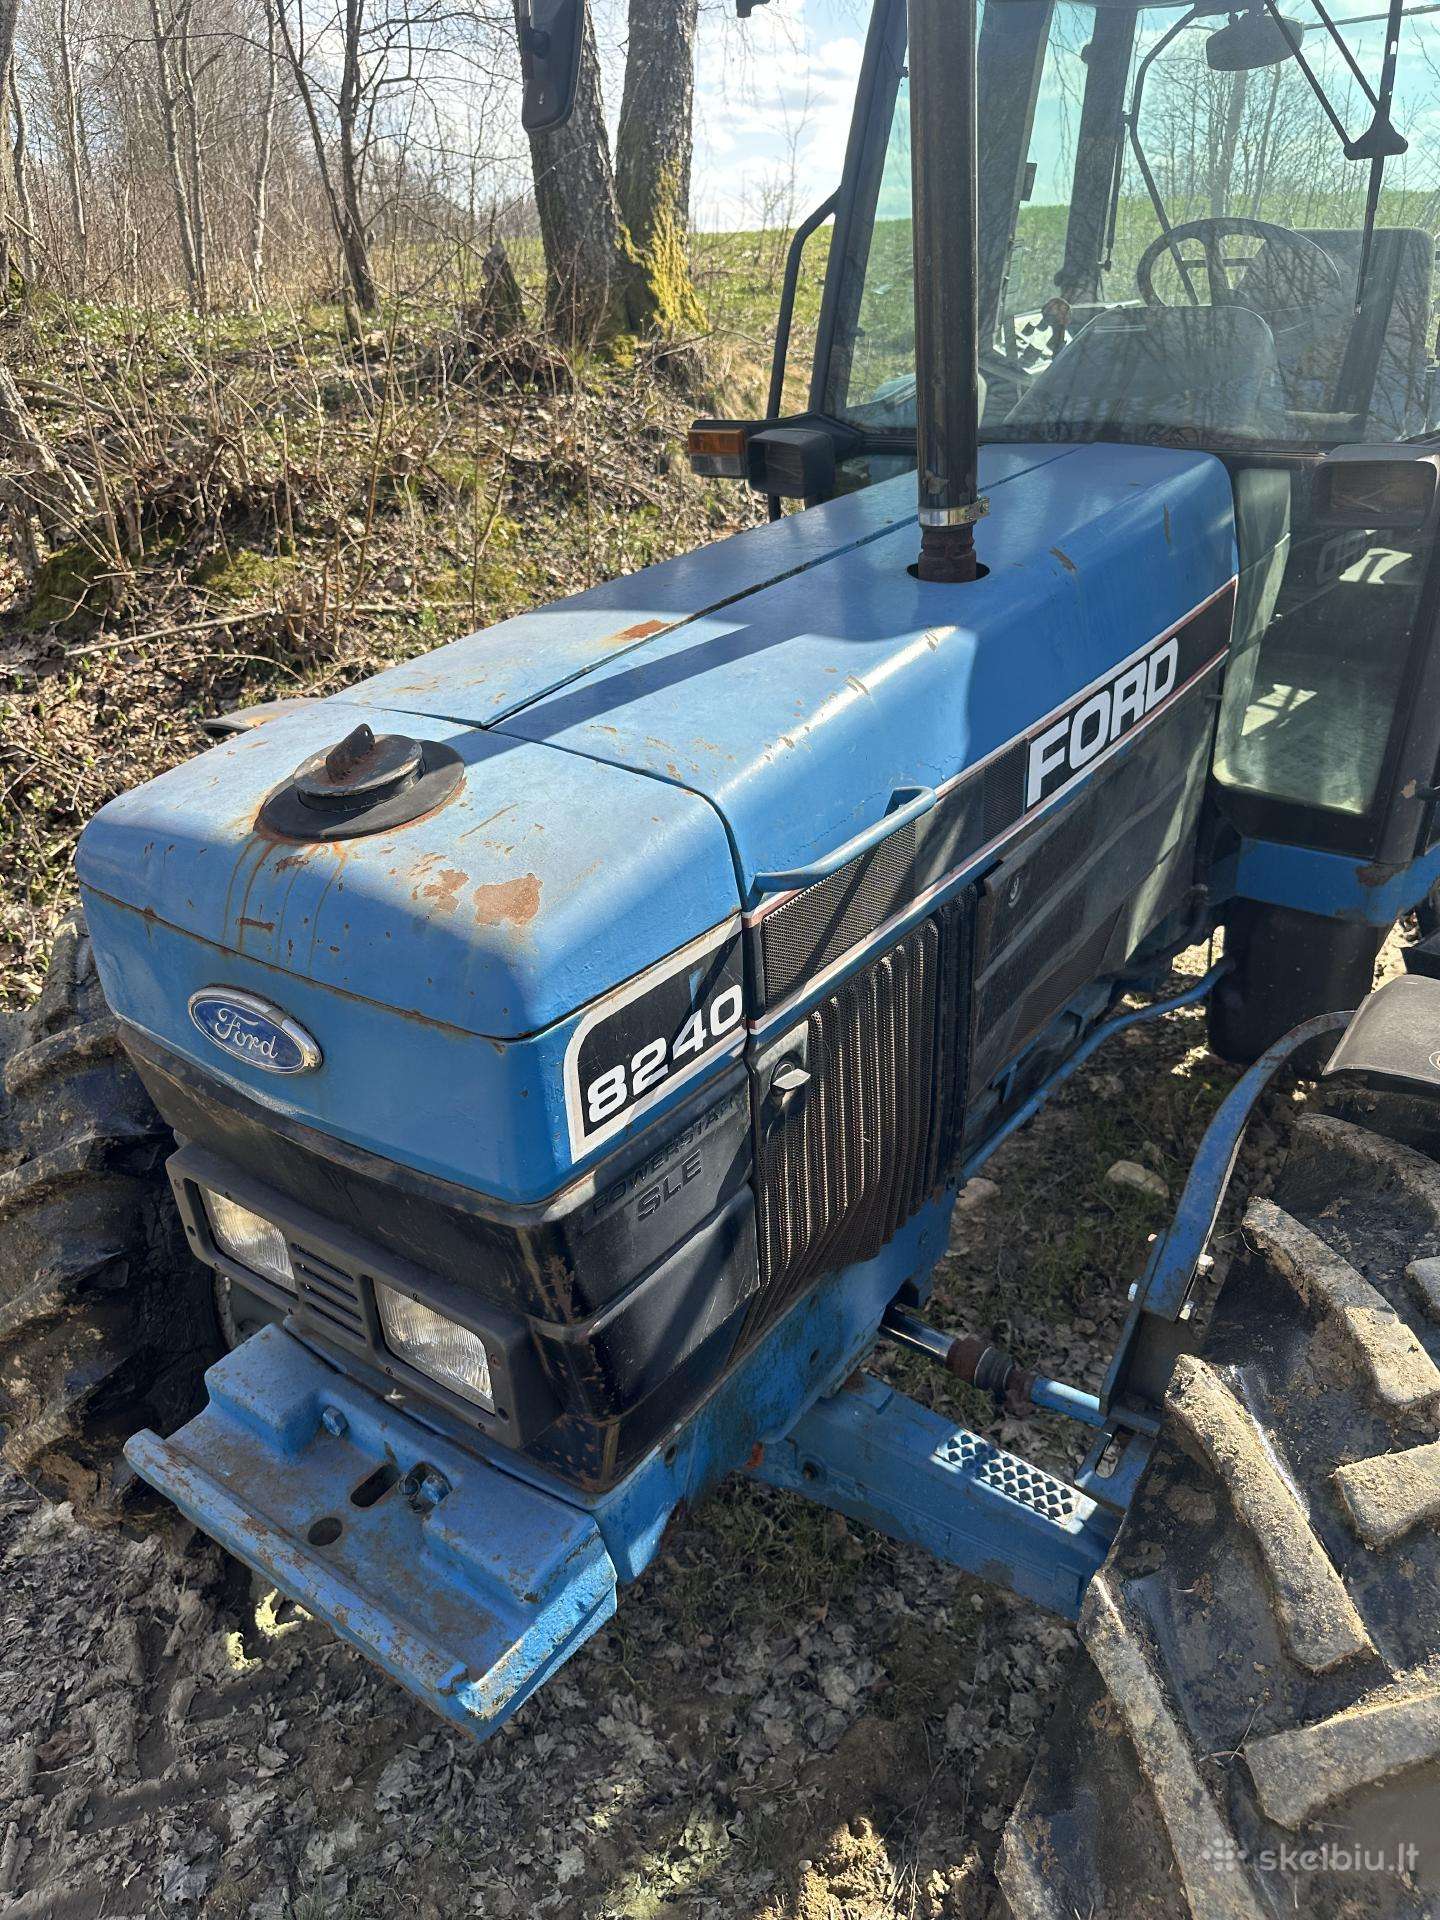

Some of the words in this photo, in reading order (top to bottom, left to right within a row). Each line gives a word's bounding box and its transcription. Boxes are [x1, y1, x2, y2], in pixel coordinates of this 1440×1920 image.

[1027, 637, 1179, 808] FORD
[214, 1007, 279, 1059] Ford
[587, 984, 743, 1123] 8240
[637, 1148, 702, 1222] SLE
